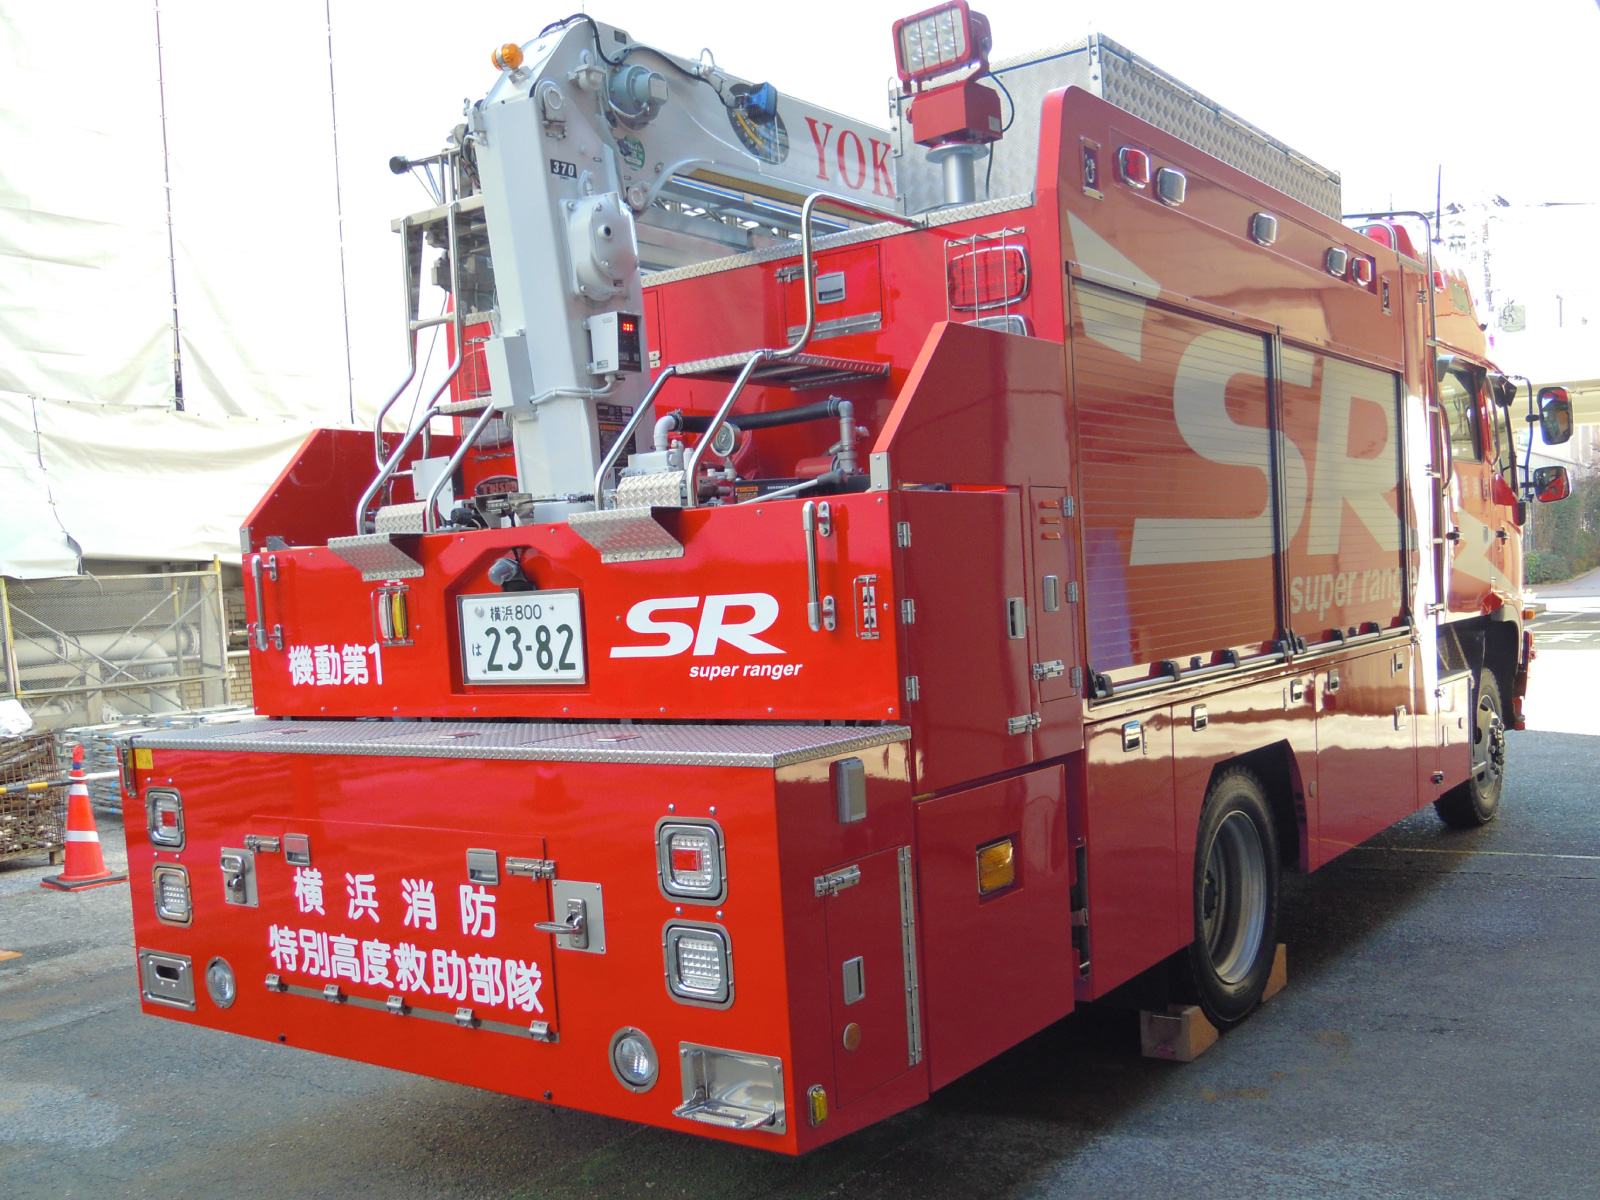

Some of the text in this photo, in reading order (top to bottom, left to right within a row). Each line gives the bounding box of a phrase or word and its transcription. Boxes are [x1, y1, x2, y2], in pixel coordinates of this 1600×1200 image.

[553, 161, 575, 176] 370
[805, 116, 895, 200] YOK
[1129, 327, 1419, 567] SR
[1290, 571, 1358, 621] super
[485, 624, 576, 671] 23-82
[609, 592, 788, 658] SR
[288, 643, 383, 686] 機動第1
[472, 644, 482, 657] は
[689, 664, 803, 681] super ranger
[268, 923, 544, 1013] 特別高度救助部隊
